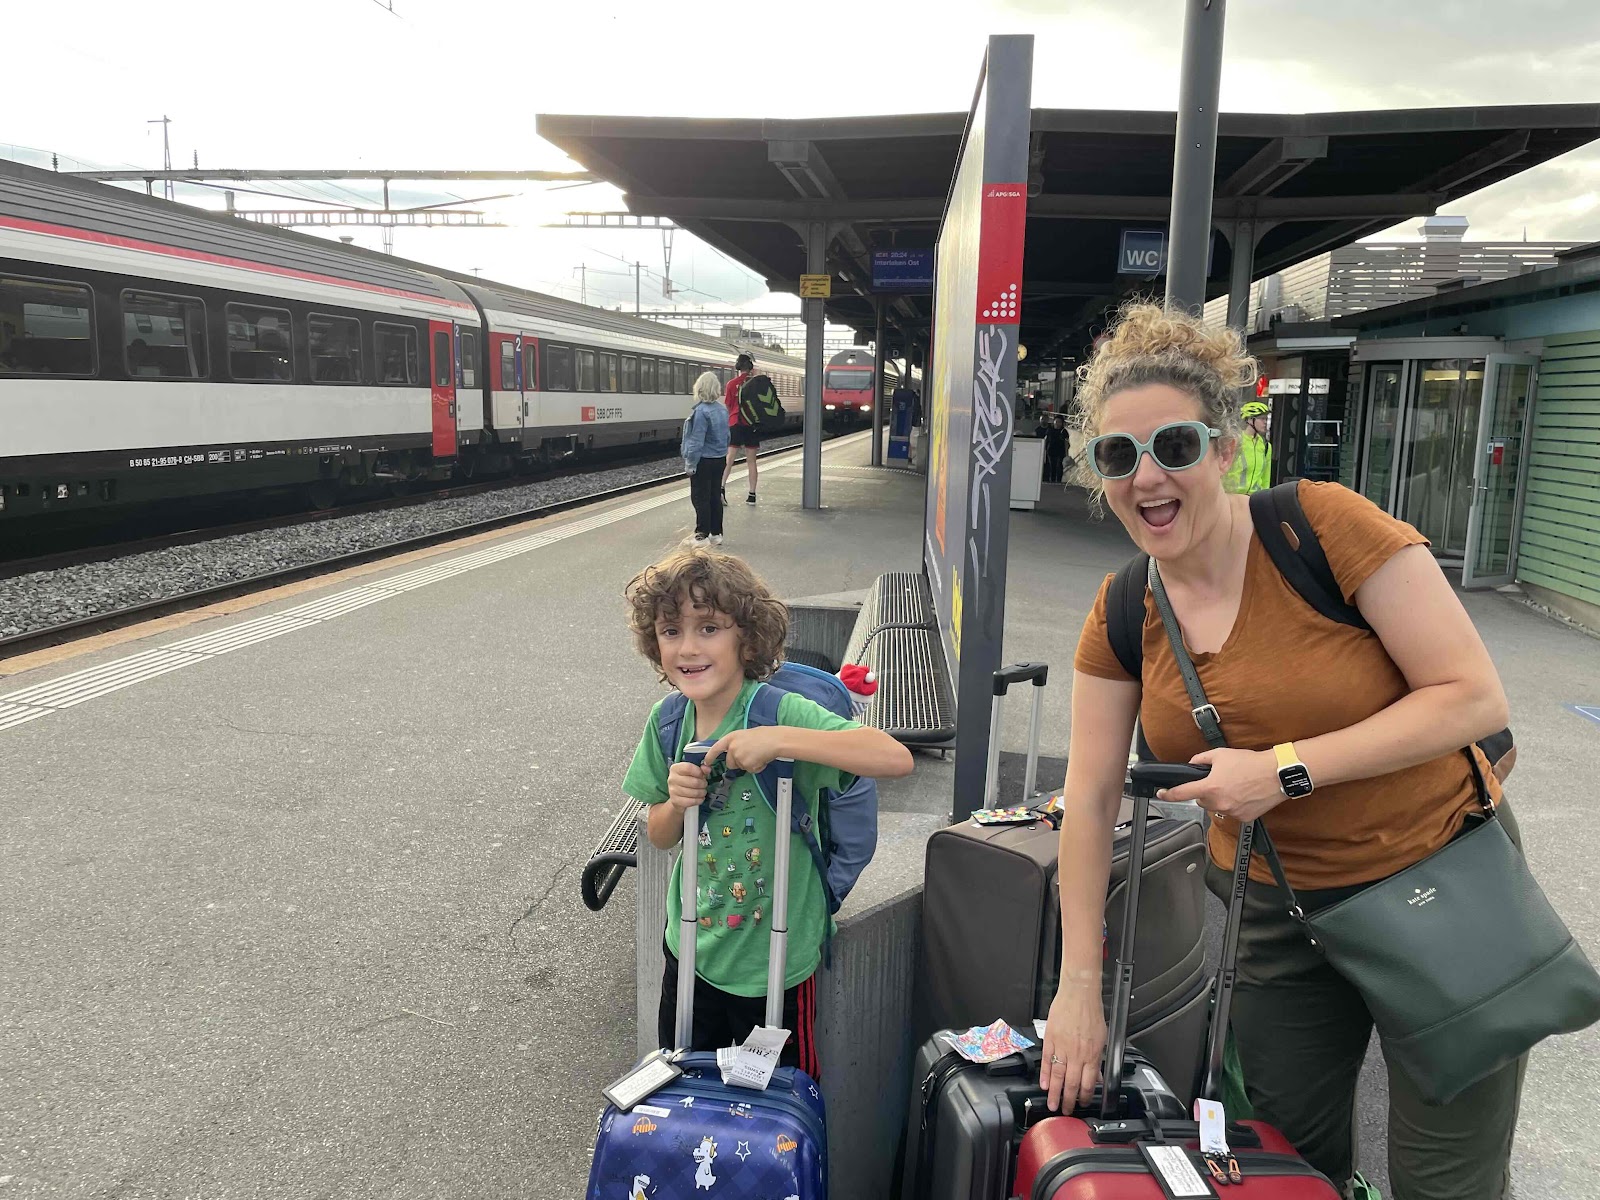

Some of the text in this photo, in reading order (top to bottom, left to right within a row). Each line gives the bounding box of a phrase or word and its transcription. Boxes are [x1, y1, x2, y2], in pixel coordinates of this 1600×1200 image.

[1126, 249, 1158, 267] WC
[455, 325, 460, 337] 2
[515, 337, 521, 352] 2
[596, 408, 622, 419] SBB CFF FFS
[1235, 825, 1252, 900] TIMBERLAND
